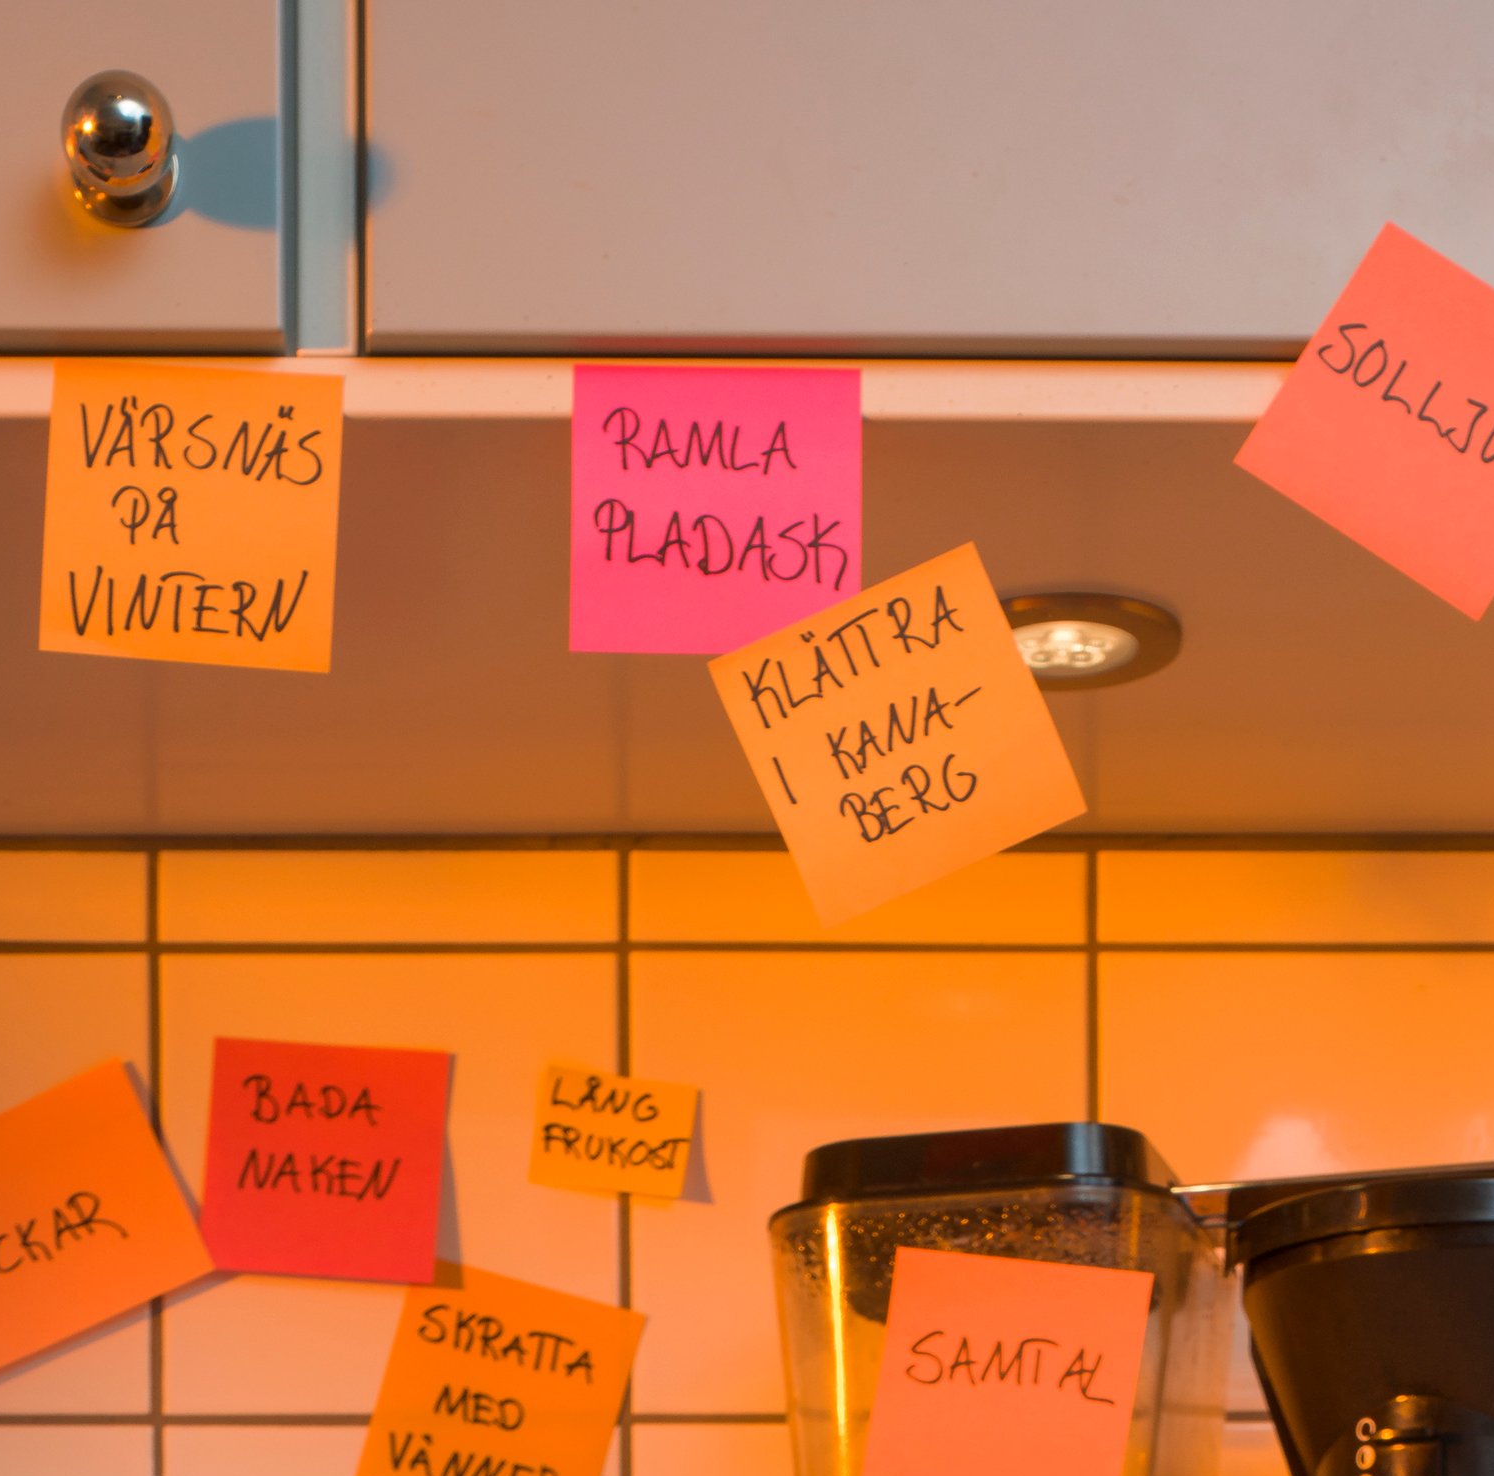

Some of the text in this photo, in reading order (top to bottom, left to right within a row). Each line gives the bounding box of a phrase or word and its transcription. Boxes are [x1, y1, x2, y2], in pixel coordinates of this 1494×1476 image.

[82, 396, 323, 485] VÄRSNÄS
[604, 408, 797, 474] RAMLA
[112, 487, 180, 546] PÅ
[595, 499, 846, 590] PLADASK
[69, 570, 308, 640] VINTERN
[743, 586, 964, 729] KLÄTTRA
[773, 685, 983, 804] I KANA-
[841, 756, 976, 843] BERG
[242, 1075, 381, 1127] BADA
[552, 1076, 659, 1123] LÅNG
[238, 1150, 401, 1199] NAKEN
[542, 1124, 689, 1171] FRUKOST
[417, 1304, 593, 1383] SKRATTA
[906, 1331, 1115, 1405] SAMTAL
[434, 1387, 525, 1432] MED
